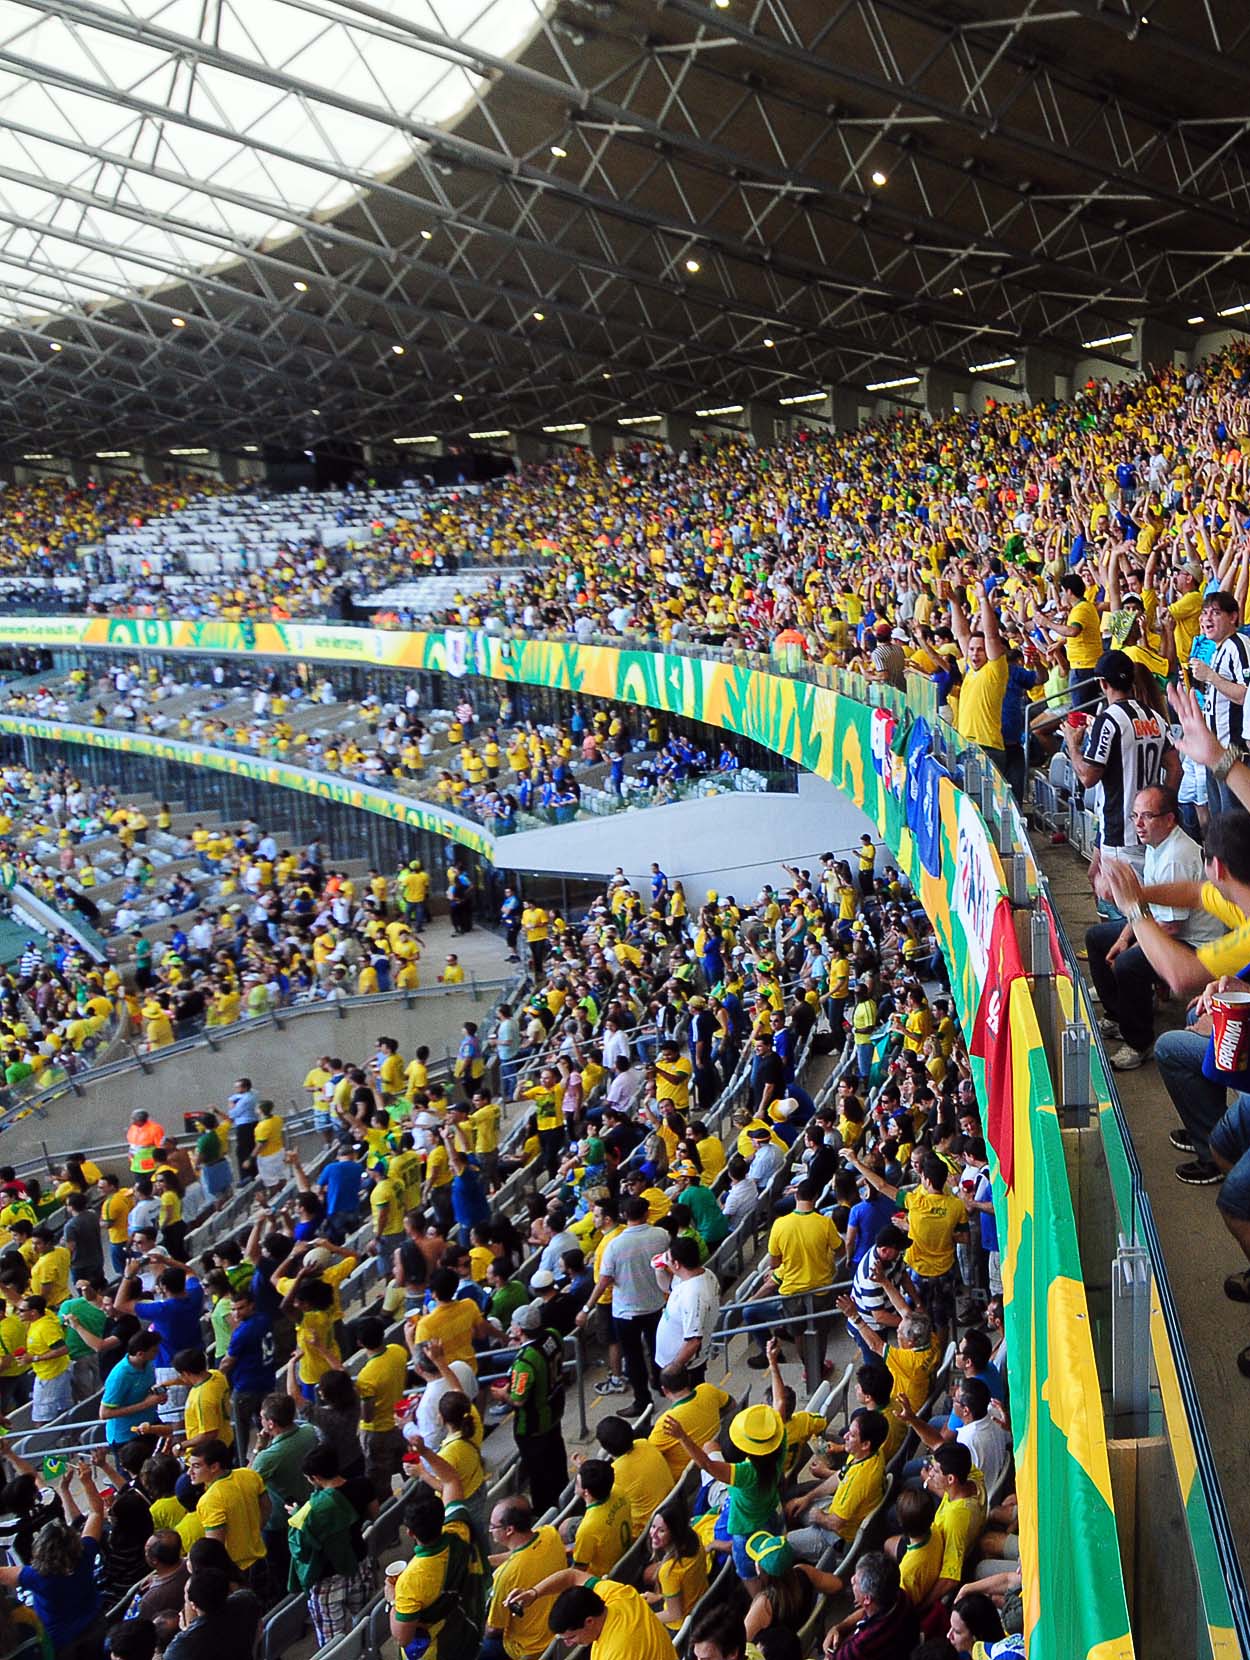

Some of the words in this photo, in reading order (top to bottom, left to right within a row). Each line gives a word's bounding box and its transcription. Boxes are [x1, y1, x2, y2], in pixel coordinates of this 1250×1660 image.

[1098, 726, 1110, 758] MRV
[1136, 743, 1160, 791] 10
[1218, 1019, 1243, 1070] BRAHMA
